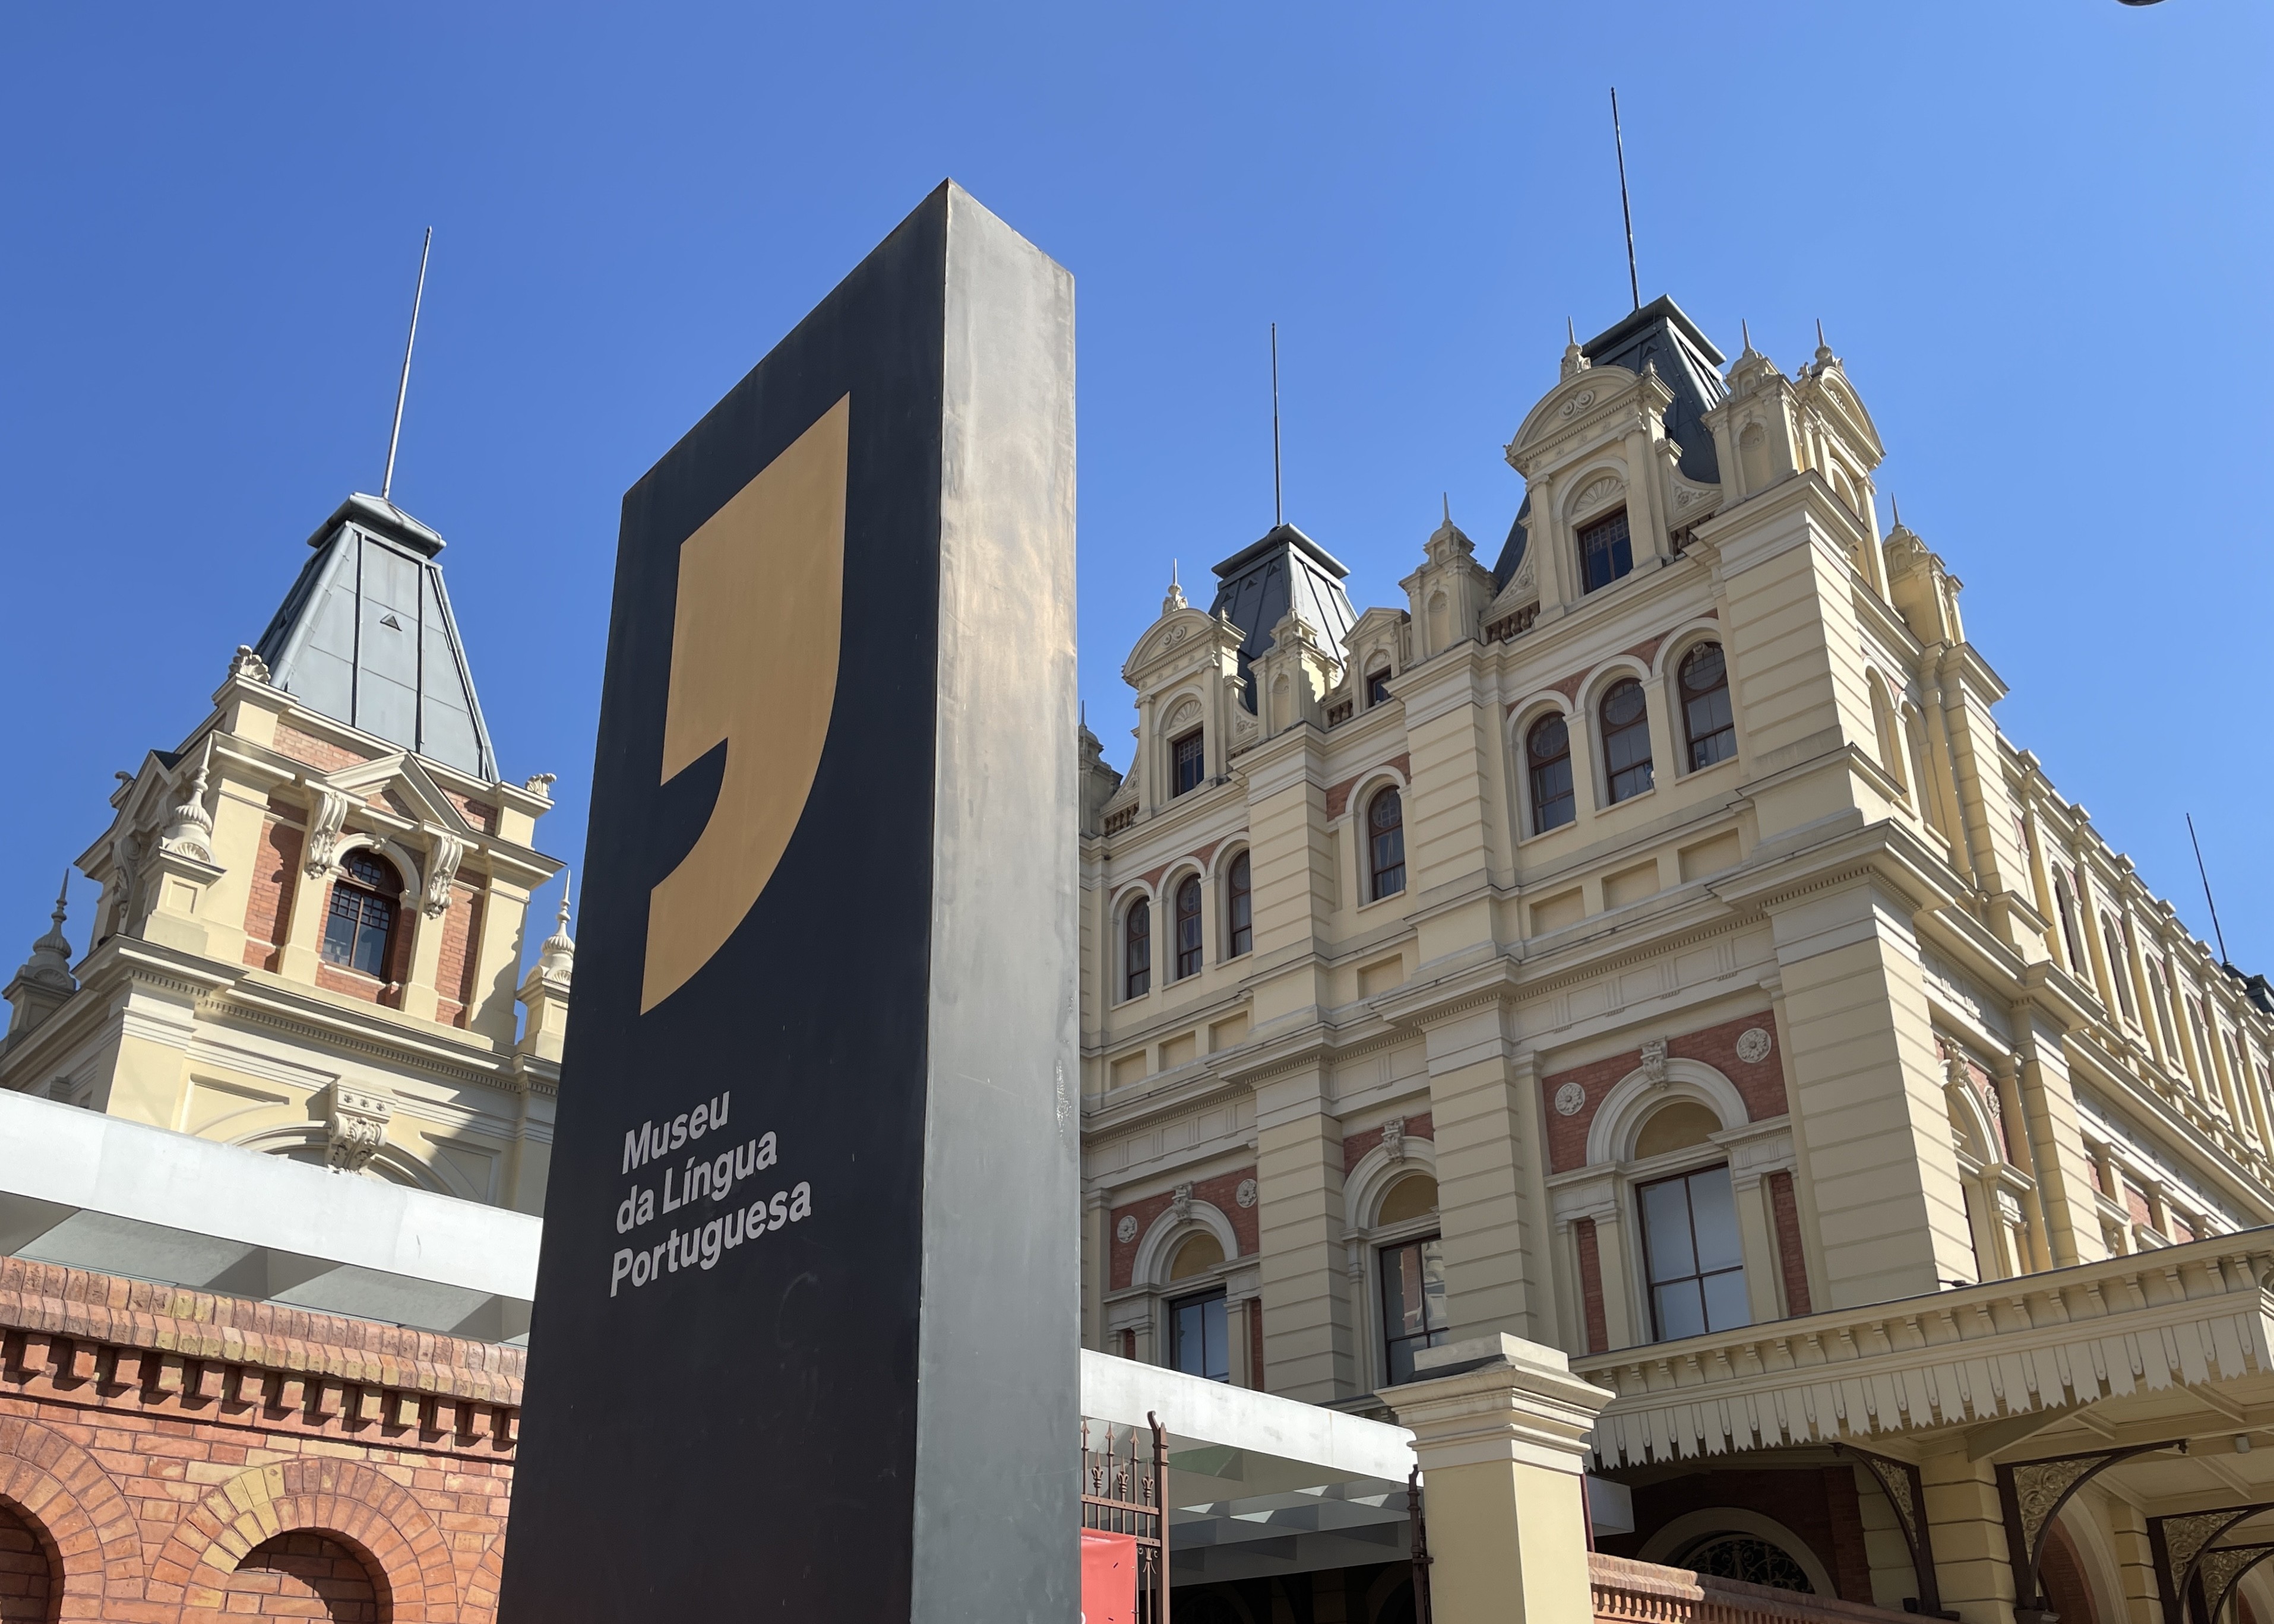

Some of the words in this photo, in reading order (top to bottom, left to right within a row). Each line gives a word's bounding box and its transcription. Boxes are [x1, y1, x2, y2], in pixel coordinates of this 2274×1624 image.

[616, 1185, 654, 1234] da
[662, 1131, 777, 1214] Língua
[622, 1091, 730, 1175] Museu
[610, 1181, 811, 1297] Portuguesa
